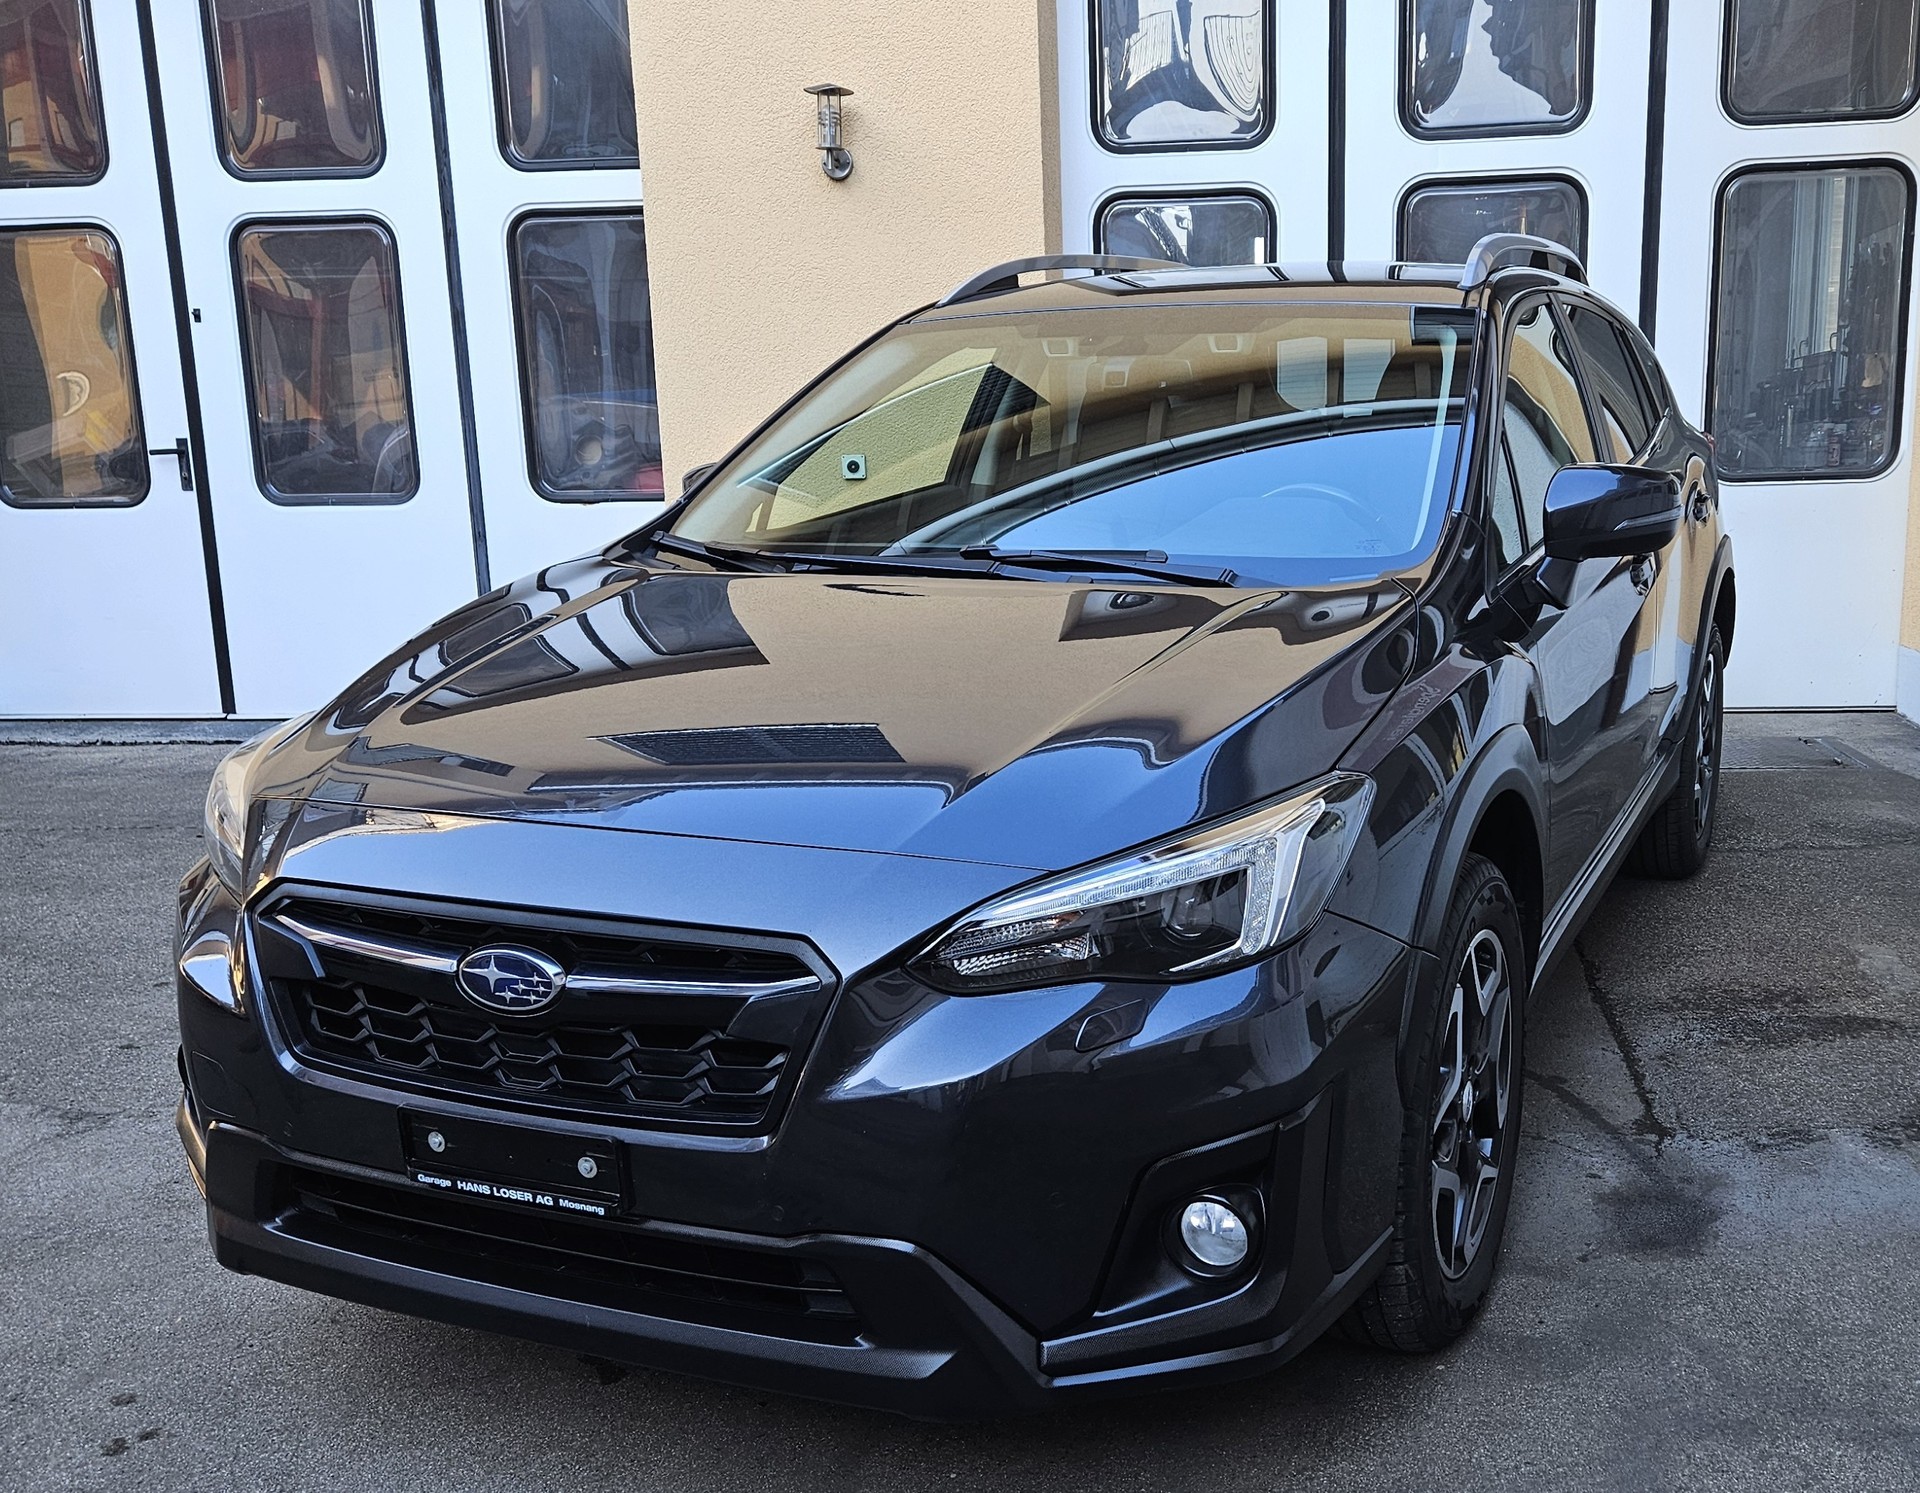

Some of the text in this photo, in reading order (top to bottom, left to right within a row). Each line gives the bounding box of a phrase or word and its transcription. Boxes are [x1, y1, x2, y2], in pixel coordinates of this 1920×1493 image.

[417, 1173, 605, 1215] Garage HANS LOSER AG Mosnang
